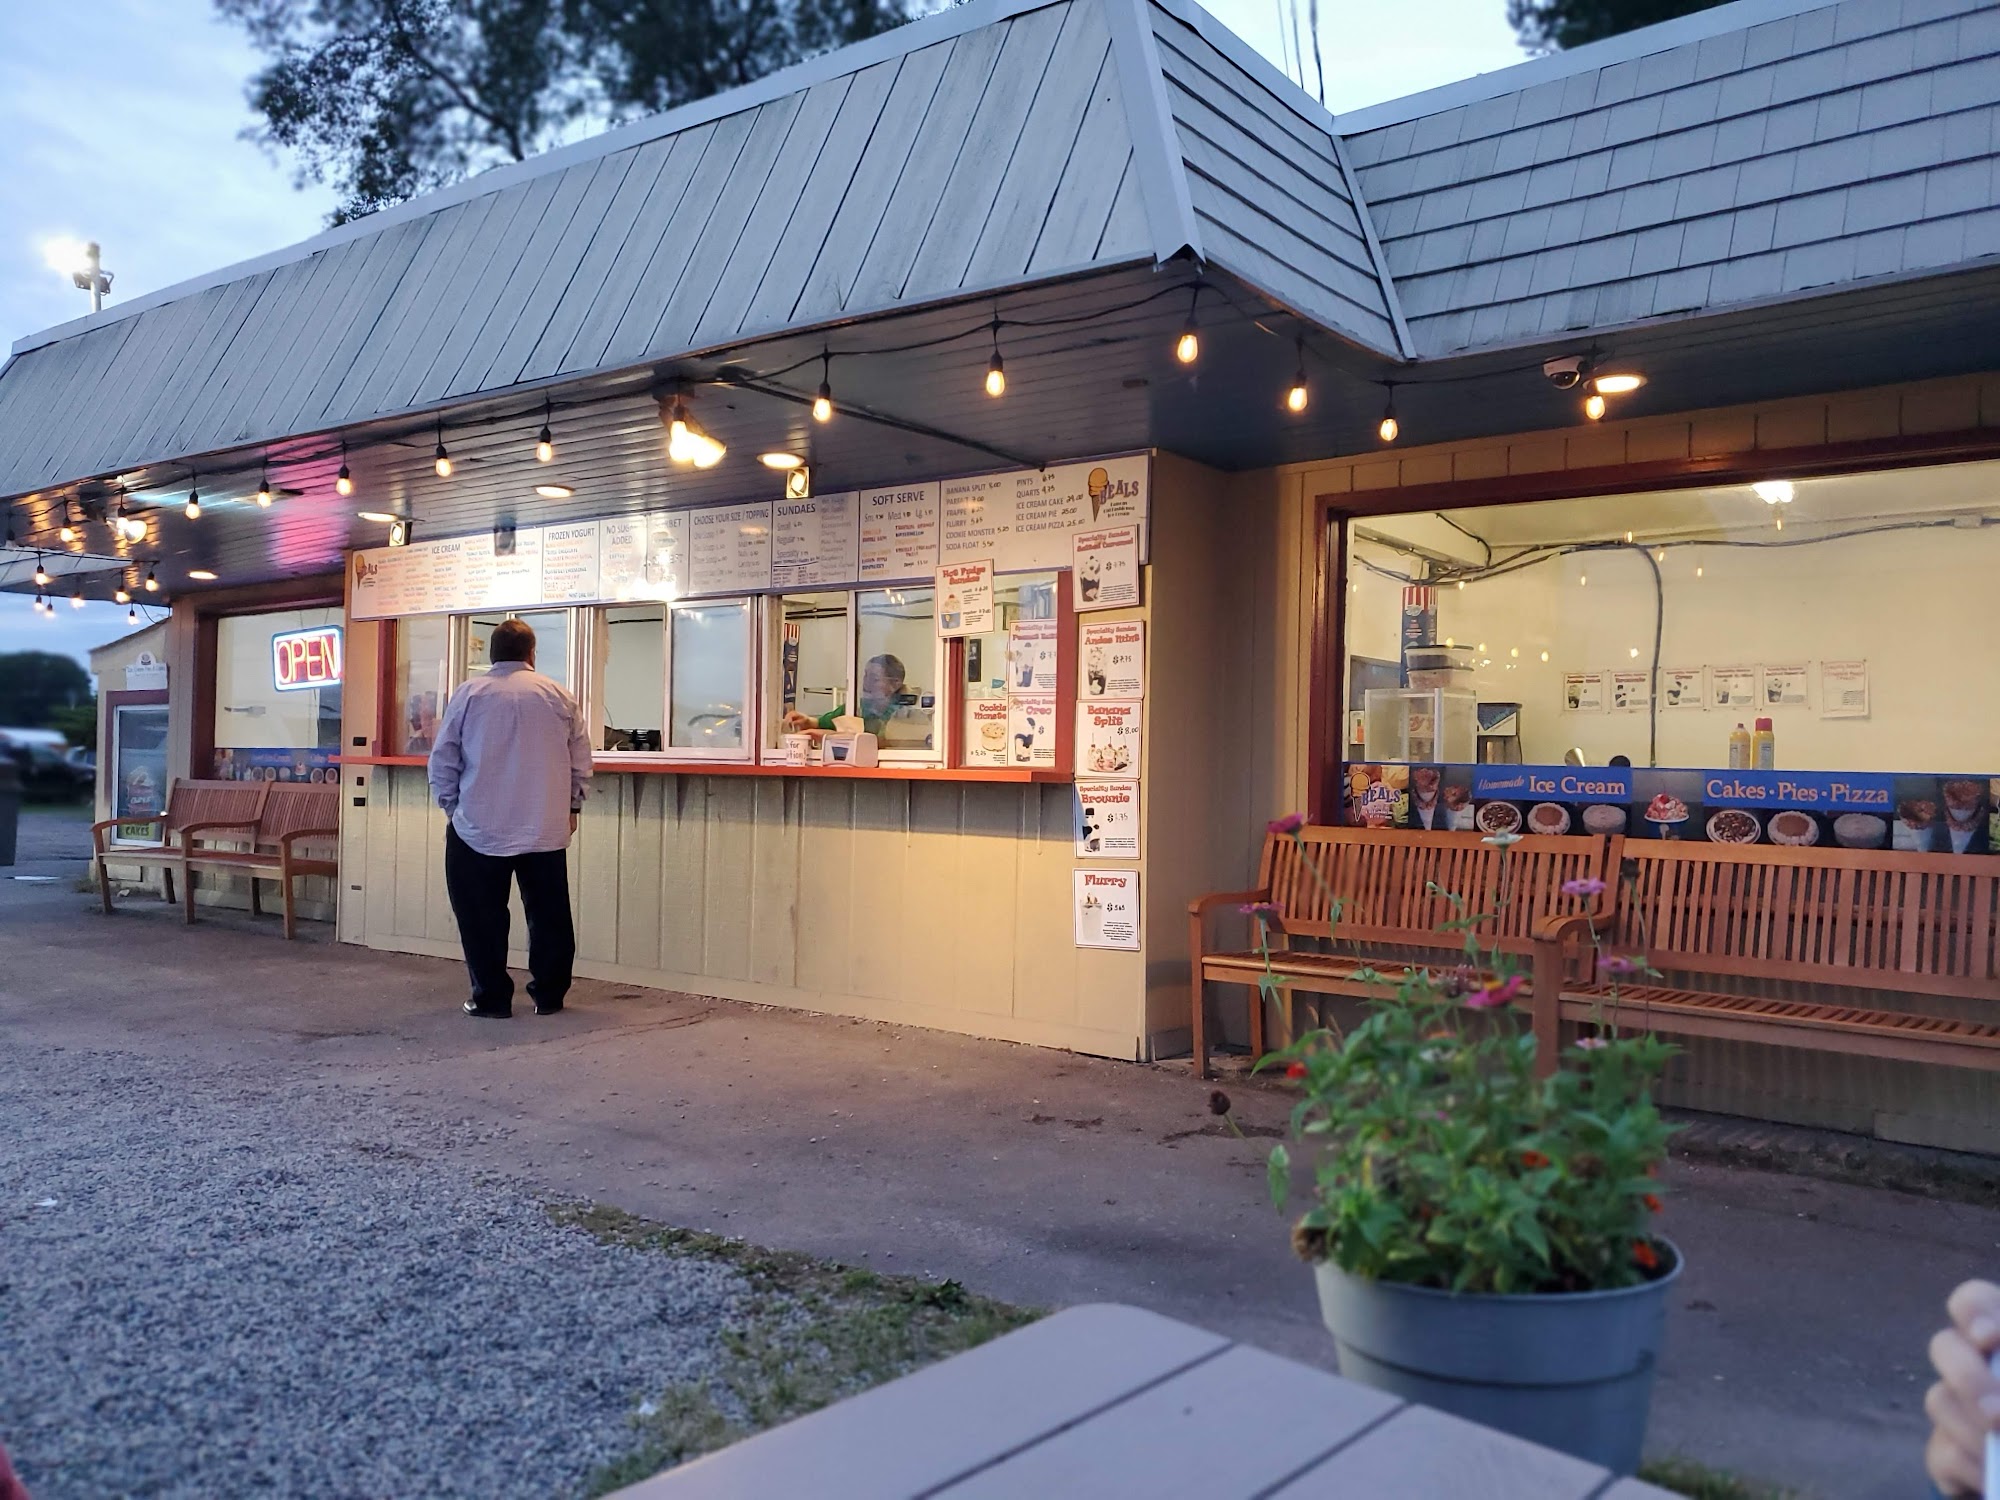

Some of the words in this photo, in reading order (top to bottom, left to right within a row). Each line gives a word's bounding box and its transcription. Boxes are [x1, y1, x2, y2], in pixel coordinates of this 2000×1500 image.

[1016, 478, 1033, 487] PINTS
[946, 485, 970, 494] BANANA
[972, 483, 987, 492] SPLIT
[1016, 488, 1040, 499] QUARTS
[1100, 479, 1140, 505] BEALS
[872, 494, 894, 506] SOFT
[896, 491, 925, 504] SERVE
[1016, 502, 1025, 510] ICE
[1026, 500, 1048, 509] CREAM
[1048, 497, 1063, 506] CAKE
[777, 503, 816, 516] SUNDAES
[946, 509, 967, 517] FRAPPE
[1015, 513, 1025, 521] ICE
[1026, 511, 1047, 520] CREAM
[1048, 509, 1057, 518] PIE
[694, 515, 714, 525] CHOOSE
[715, 513, 730, 523] YOUR
[730, 512, 741, 522] SIZE
[746, 509, 769, 520] TOPPING
[946, 520, 967, 528] FLURRY
[1015, 525, 1025, 533] ICE
[1026, 523, 1047, 532] CREAM
[1047, 521, 1065, 530] PIZZA
[548, 530, 570, 541] FROZEN
[571, 527, 595, 539] YOGURT
[607, 525, 616, 535] NO
[946, 531, 967, 540] COOKIE
[967, 528, 996, 537] MONSTER
[612, 535, 633, 545] ADDED
[776, 536, 796, 546] Regular
[431, 546, 441, 554] ICE
[441, 543, 461, 553] CREAM
[945, 543, 961, 551] SODA
[962, 541, 979, 549] FLOAT
[942, 568, 959, 578] Hot
[960, 566, 986, 578] Fudge
[1116, 625, 1138, 633] Sundae
[1084, 635, 1113, 646] Andes
[277, 635, 339, 685] OPEN
[1026, 705, 1052, 715] Oreo
[1087, 705, 1132, 716] Banana
[974, 712, 1007, 720] Monste
[1093, 715, 1124, 728] Split
[789, 740, 800, 749] for
[1478, 774, 1525, 792] Homemade
[1529, 775, 1556, 794] Ice
[1560, 775, 1627, 796] Cream
[1362, 786, 1401, 806] BEALS
[1706, 778, 1767, 801] Cakes
[1777, 781, 1819, 803] Pies
[1829, 782, 1889, 805] Pizza
[1081, 792, 1130, 804] Brownie
[125, 826, 151, 837] CAKES
[1084, 874, 1128, 888] Flurry
